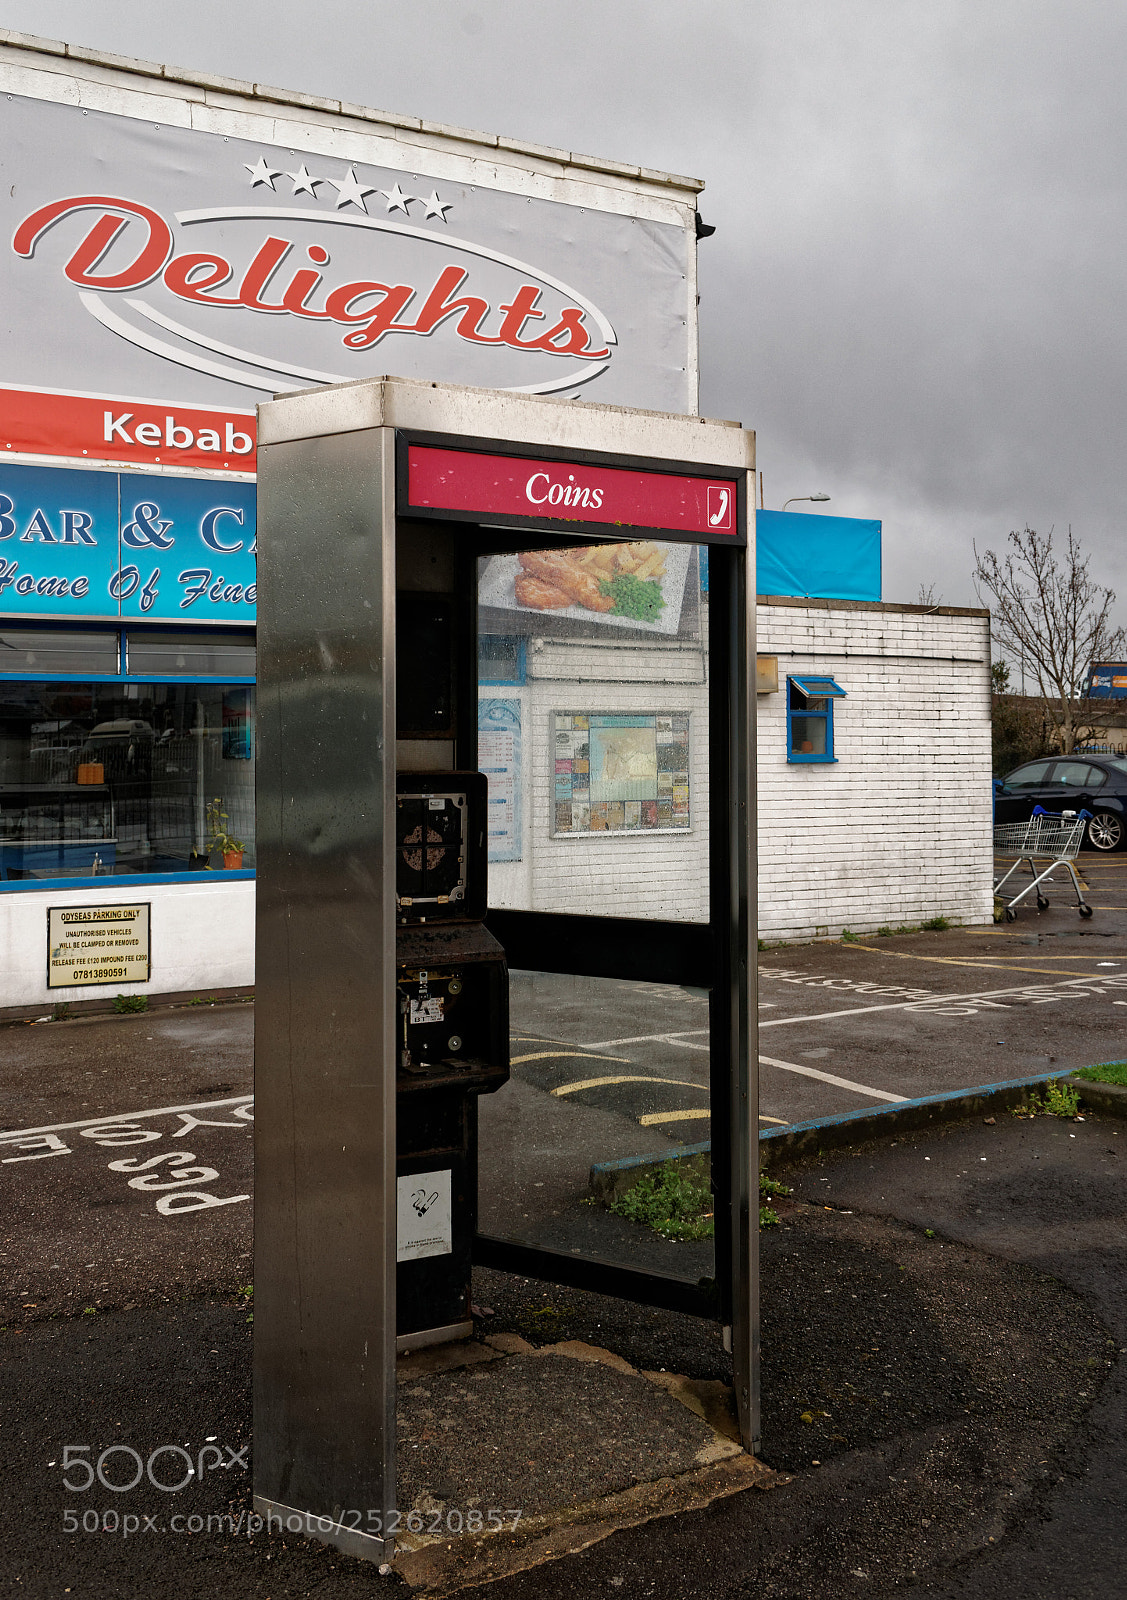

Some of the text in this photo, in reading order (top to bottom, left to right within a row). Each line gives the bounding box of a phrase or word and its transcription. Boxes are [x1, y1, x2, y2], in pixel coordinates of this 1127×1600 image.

[12, 195, 611, 359] Delights
[103, 411, 253, 454] Kebab
[526, 473, 604, 508] Coins
[122, 501, 175, 549] &
[201, 507, 257, 553] C
[108, 565, 161, 611] Of
[61, 909, 140, 920] ODYSEAS PARKING ONLY
[65, 928, 131, 937] UNAUTHORISED VEHICLES
[81, 940, 105, 948] CLAMPED
[52, 958, 75, 966] RELEASE
